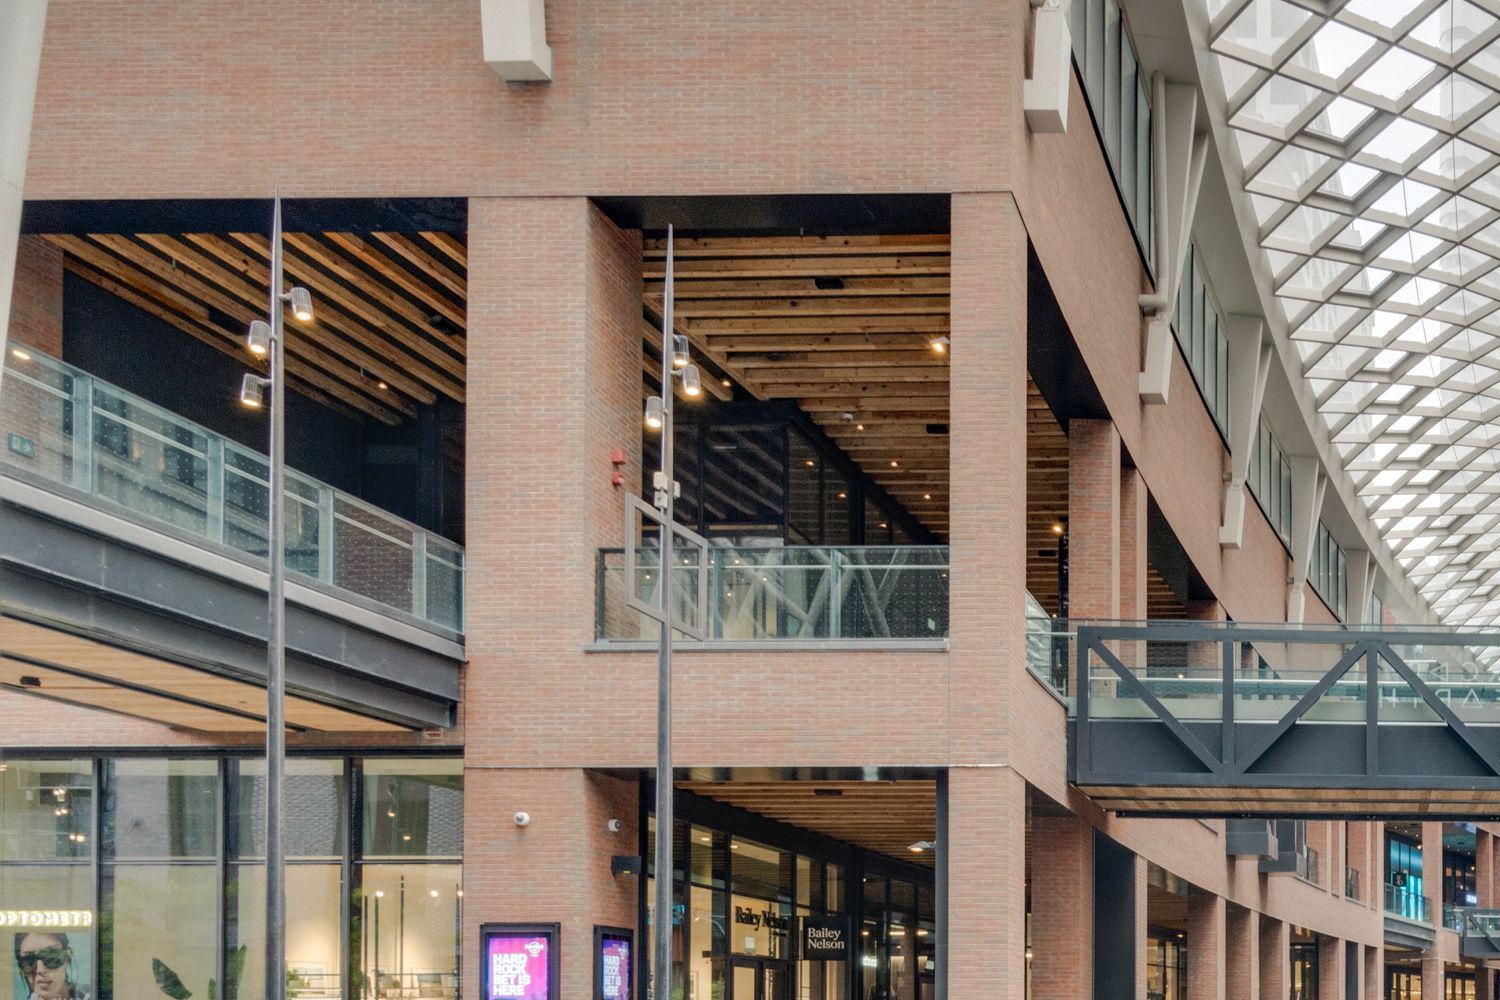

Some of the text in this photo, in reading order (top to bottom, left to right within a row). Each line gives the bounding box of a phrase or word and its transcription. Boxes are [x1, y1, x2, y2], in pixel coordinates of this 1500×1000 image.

[0, 911, 92, 926] PTOMETR
[735, 906, 761, 931] Bailey
[808, 927, 841, 939] Bailey
[808, 938, 845, 950] Nelson
[493, 953, 528, 964] HARD
[493, 964, 526, 974] ROCK
[493, 974, 532, 985] BET IS
[493, 985, 525, 996] HERE
